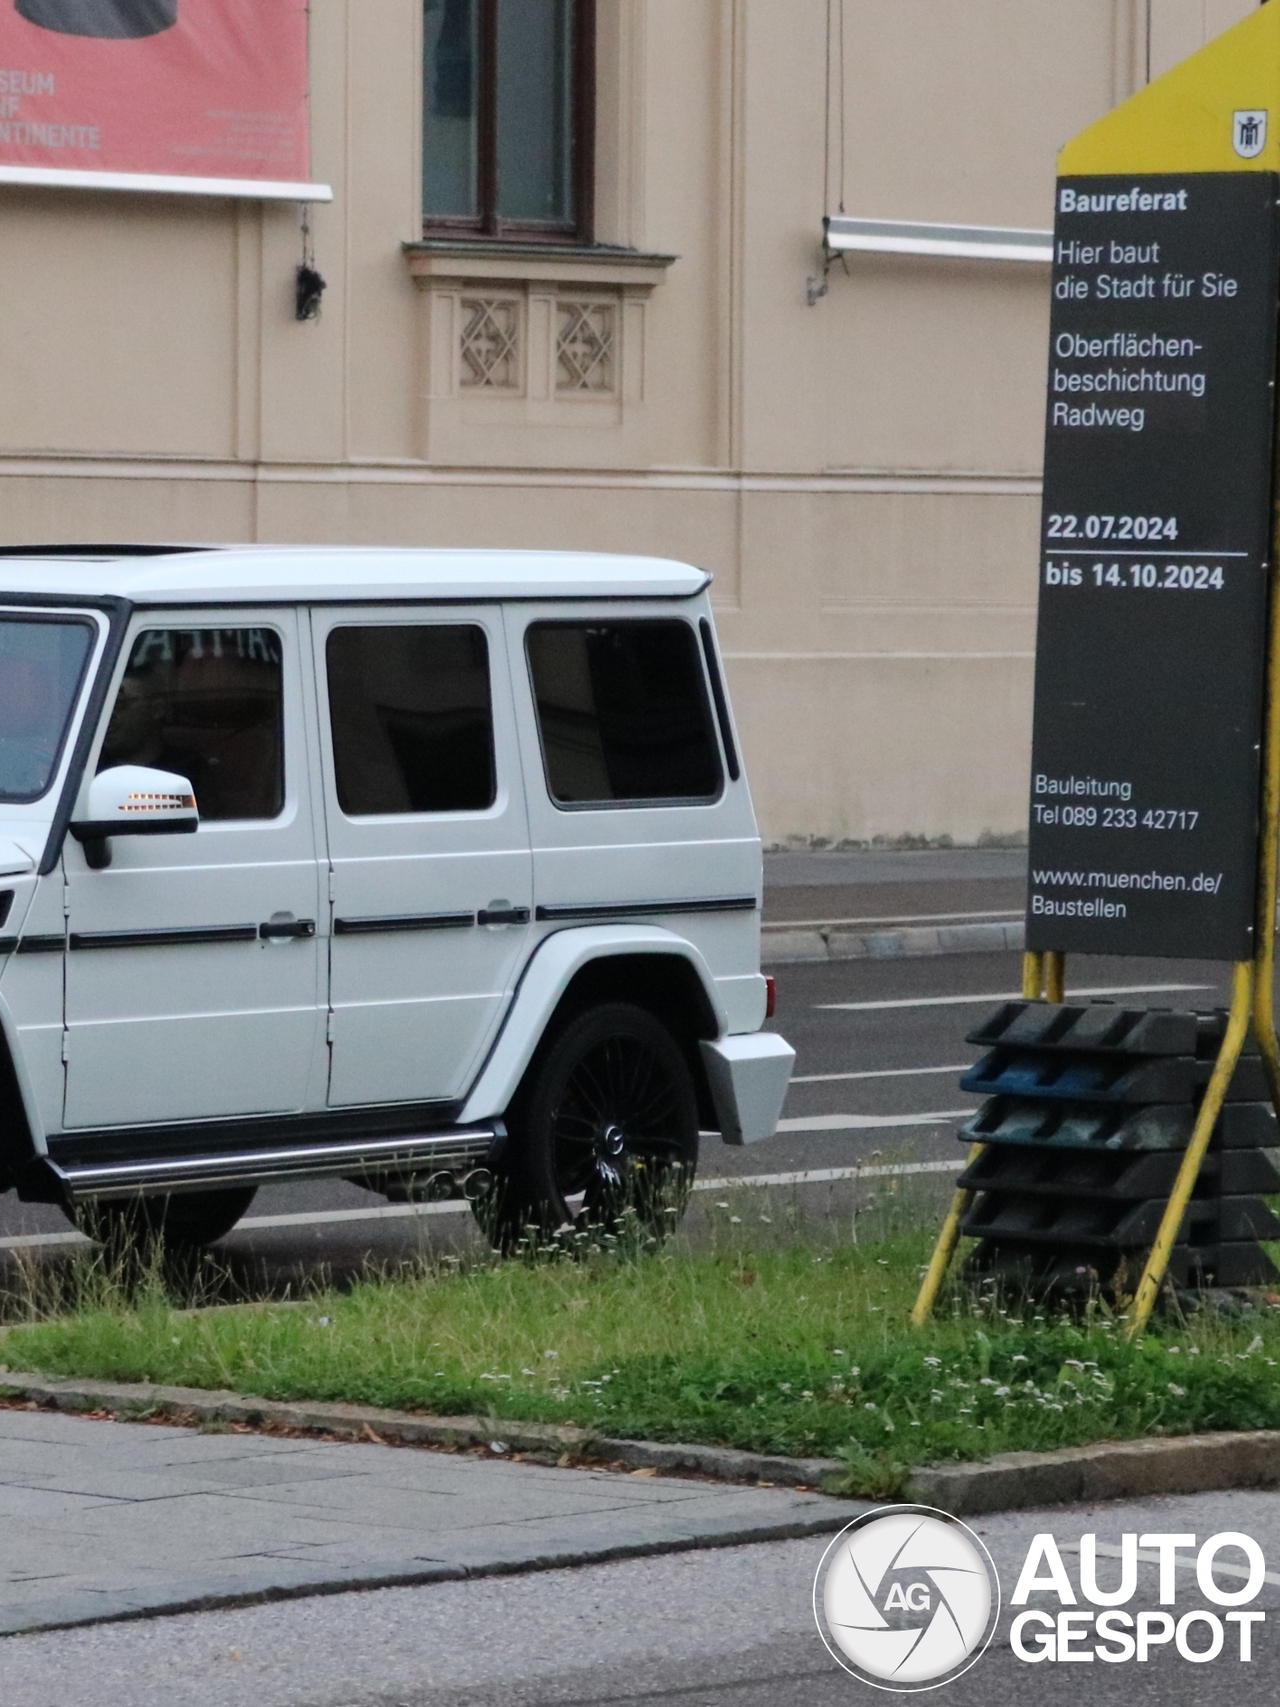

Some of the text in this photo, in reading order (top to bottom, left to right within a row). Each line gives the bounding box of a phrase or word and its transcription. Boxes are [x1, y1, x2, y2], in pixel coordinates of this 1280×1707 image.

[1060, 187, 1187, 212] Baureferat
[1058, 241, 1160, 264] Hier baut
[1055, 272, 1238, 299] die Stadt für Sie
[1056, 333, 1202, 358] Oberflächen-
[1054, 368, 1206, 397] beschichtung
[1053, 402, 1145, 432] Radweg
[1047, 514, 1178, 540] 22.07.2024
[1046, 562, 1225, 589] bis 14.10.2024
[1035, 775, 1132, 801] Bauleitung
[1034, 804, 1199, 830] Tel 089 233 42717
[1033, 869, 1223, 894] www.muenchen.de/
[1032, 895, 1127, 918] Baustellen
